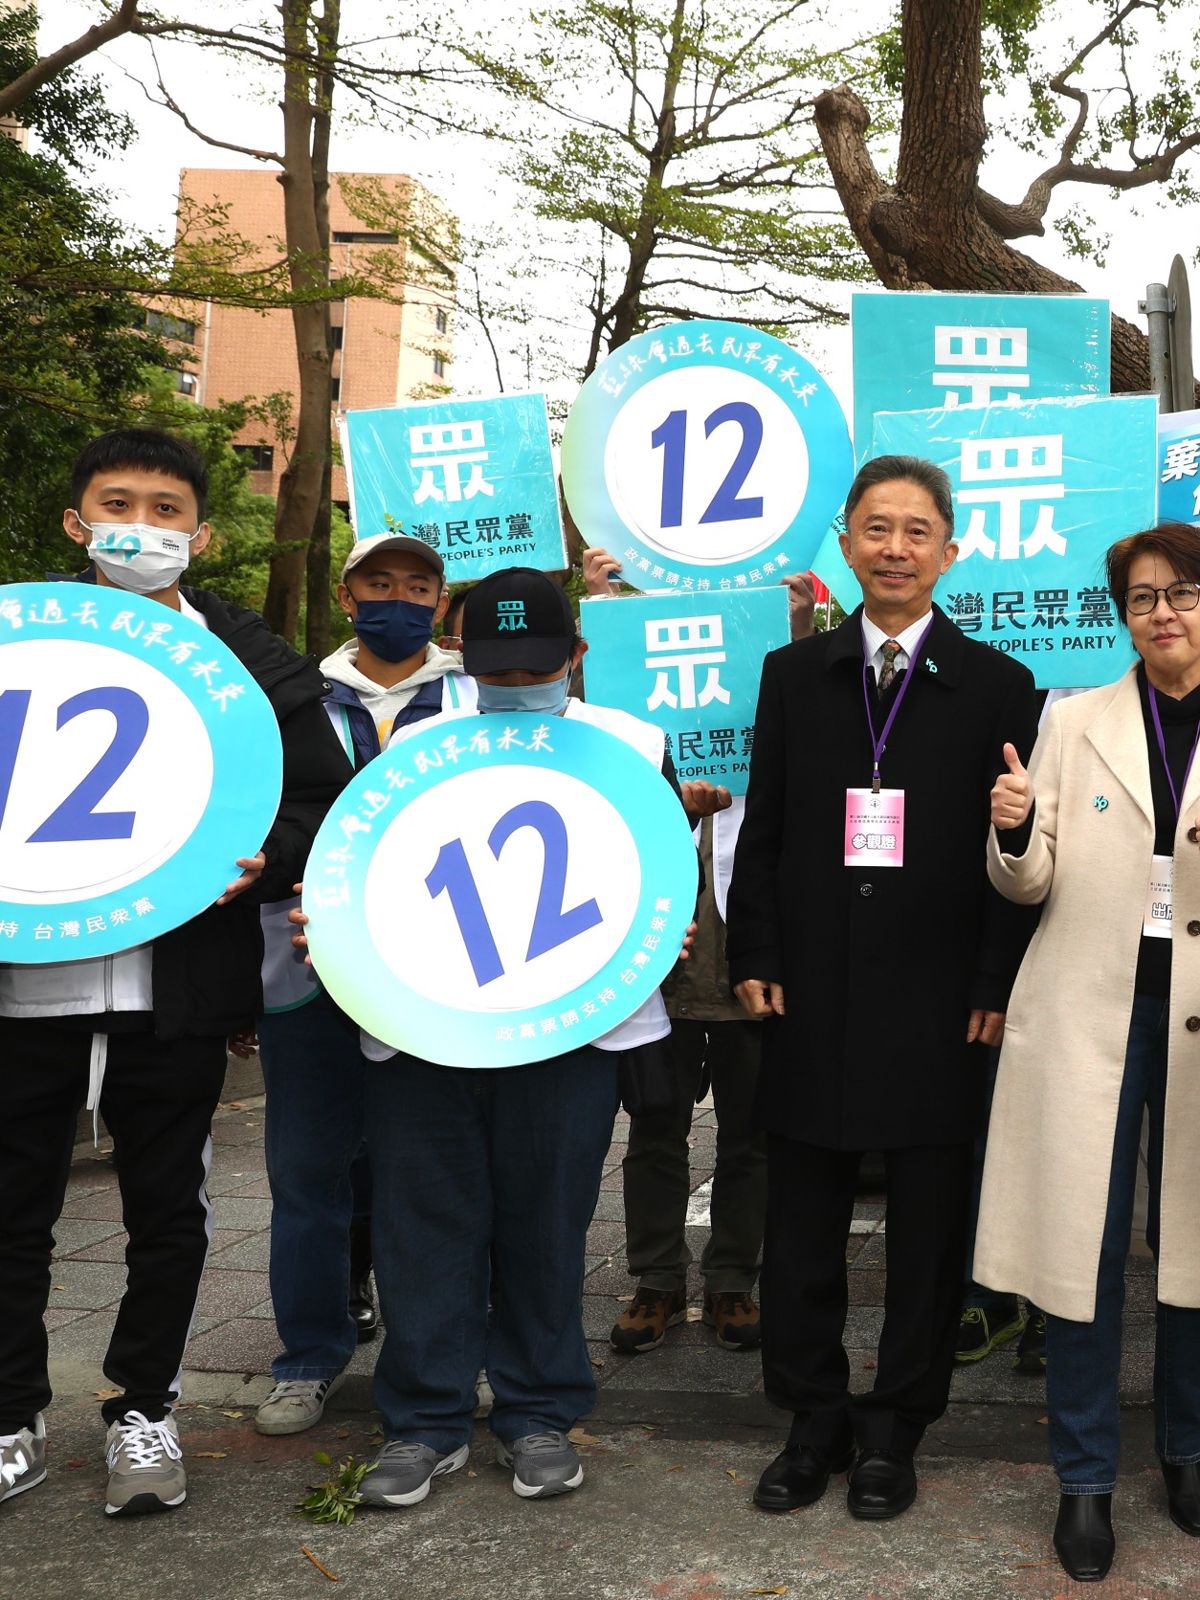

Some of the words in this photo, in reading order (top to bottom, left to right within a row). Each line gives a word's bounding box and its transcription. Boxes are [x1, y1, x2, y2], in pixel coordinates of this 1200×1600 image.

[409, 420, 494, 504] 眾
[651, 401, 764, 528] 12
[389, 512, 533, 549] 灣民眾黨
[957, 434, 1067, 561] 眾
[499, 543, 537, 556] PARTY
[497, 600, 528, 631] 眾
[946, 586, 1115, 633] 灣民眾黨
[1062, 635, 1116, 650] PARTY
[644, 614, 731, 712] 眾
[0, 686, 149, 844] 12
[424, 800, 604, 987] 12
[496, 986, 618, 1042] 政黨票請支持
